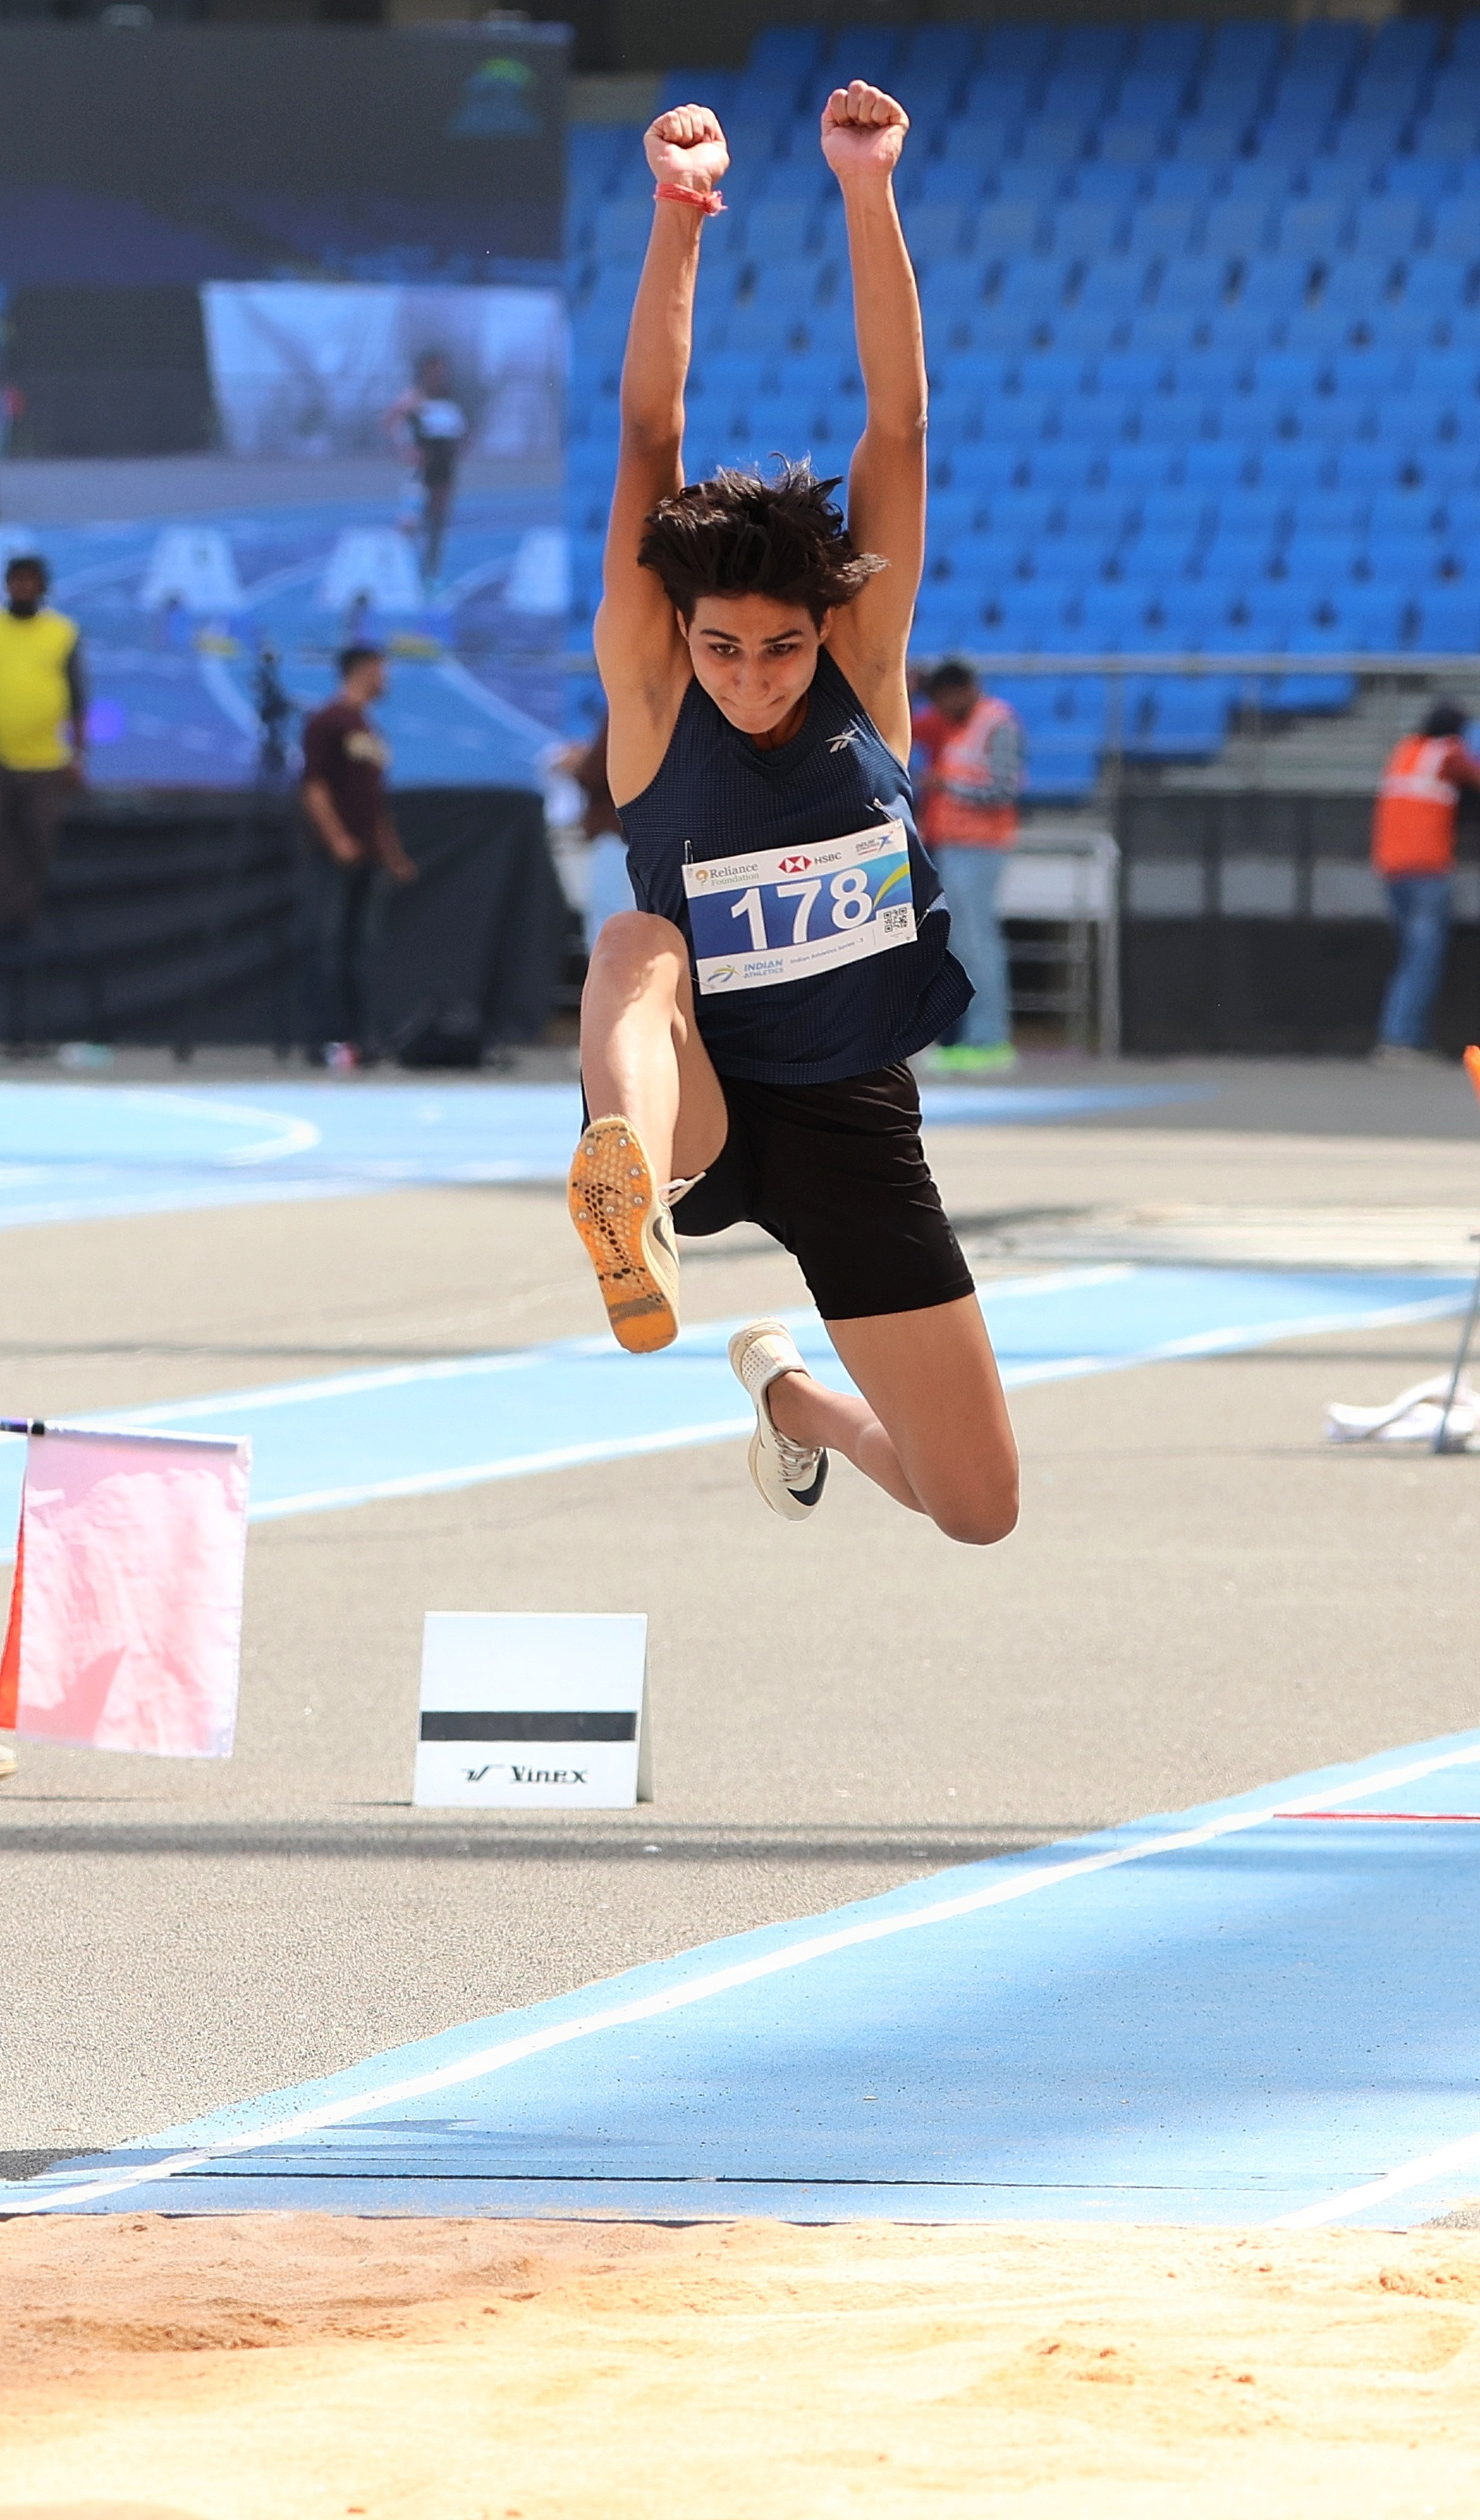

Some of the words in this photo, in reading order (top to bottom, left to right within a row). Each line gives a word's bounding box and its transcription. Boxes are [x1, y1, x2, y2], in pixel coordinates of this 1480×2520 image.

[814, 852, 842, 865] HSBC
[710, 862, 759, 879] Reliance
[710, 873, 760, 887] Foundation
[730, 868, 873, 951] 178
[744, 958, 784, 971] INDIAN
[743, 966, 785, 978] ATHLETICS
[510, 1764, 588, 1784] Vinex
